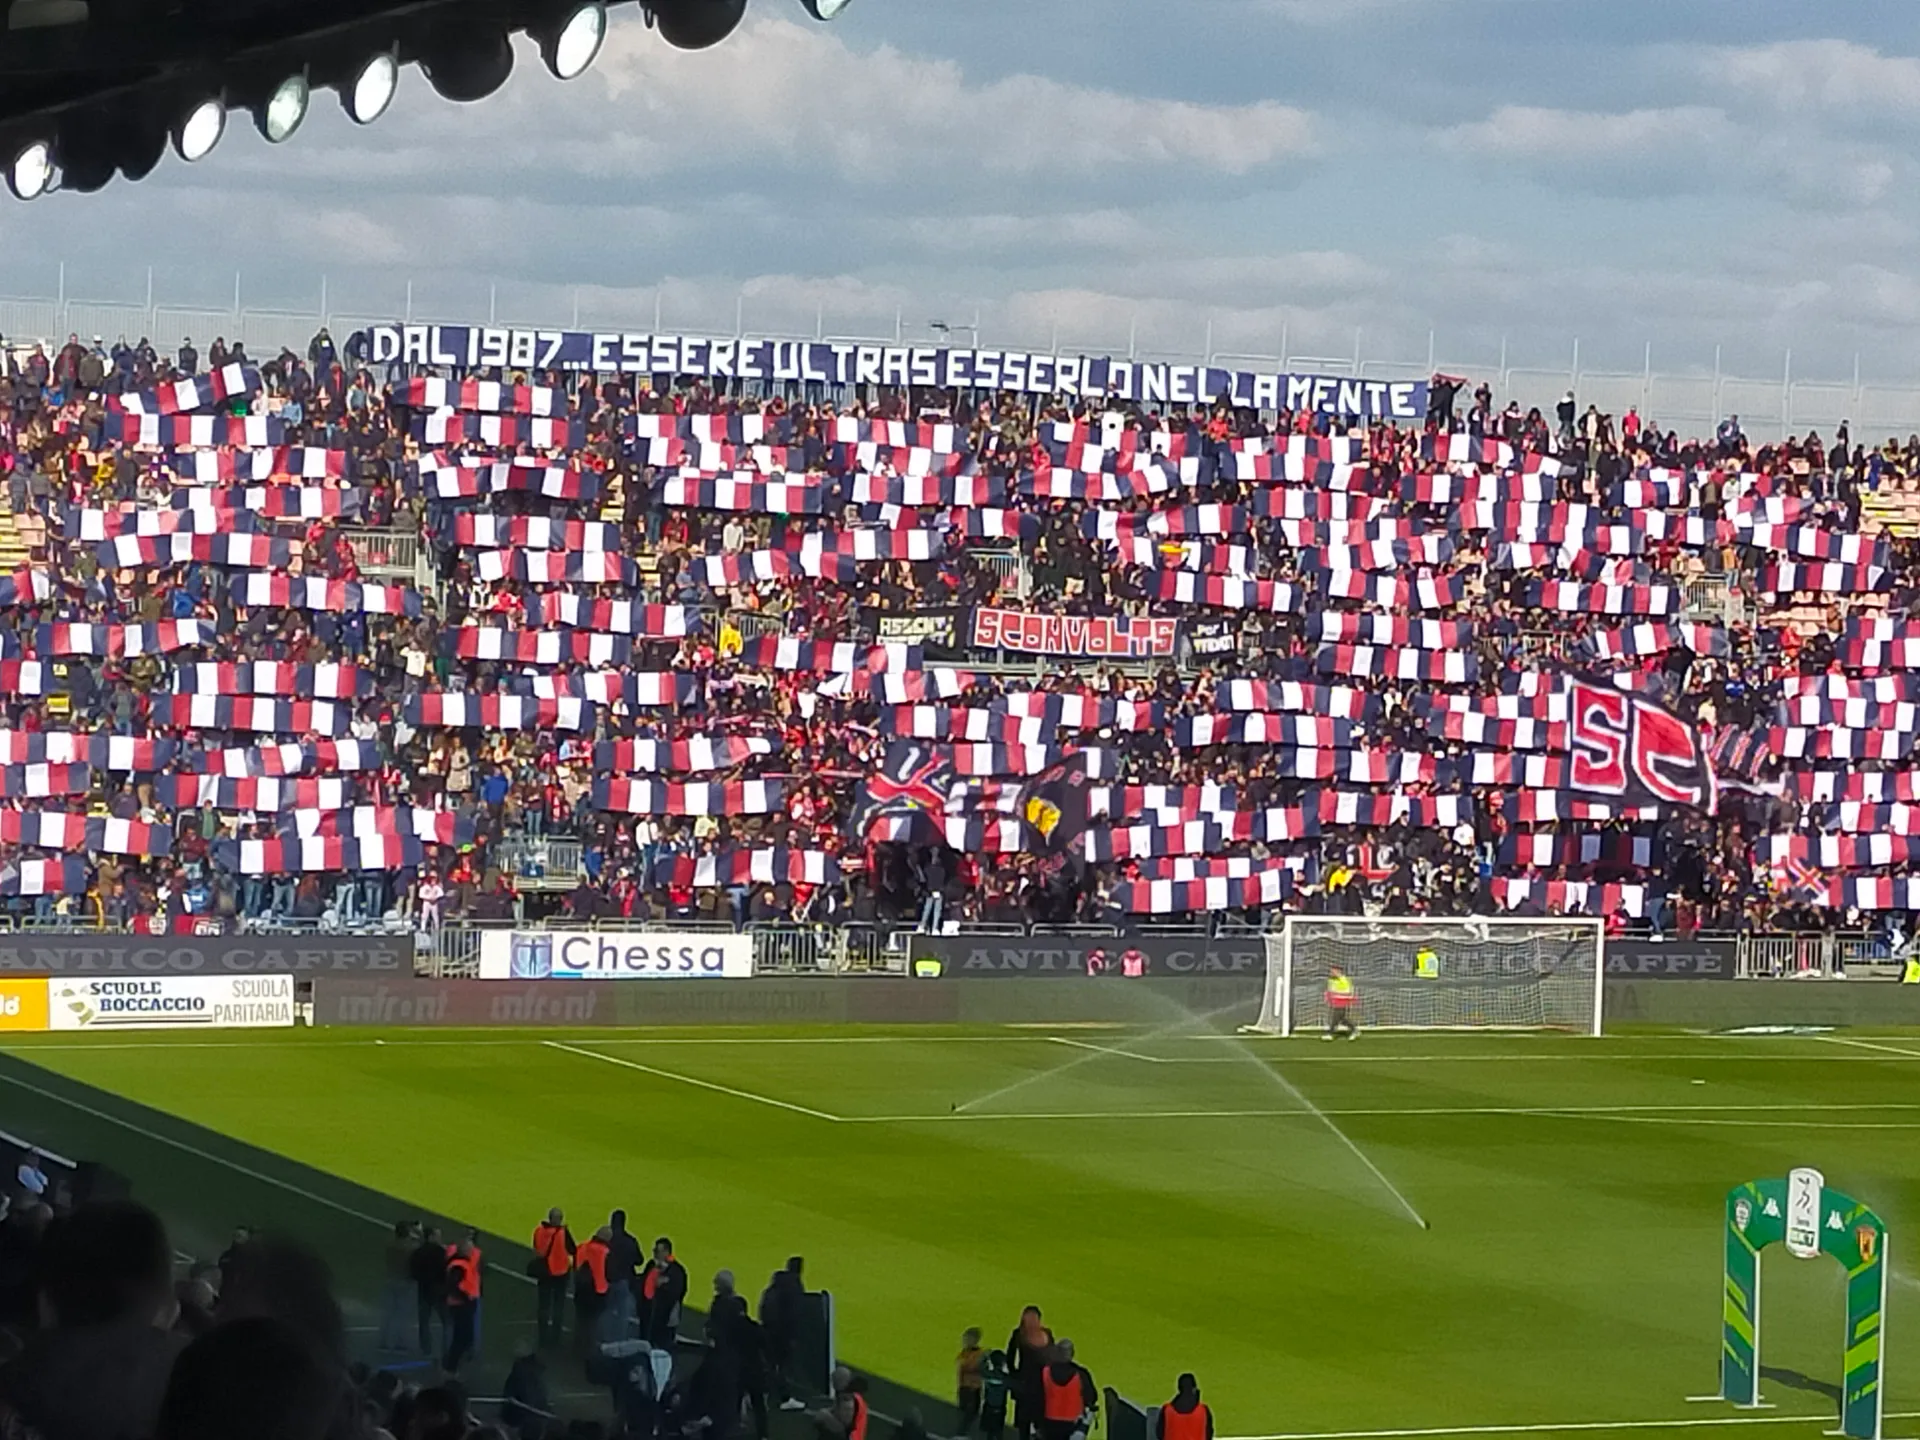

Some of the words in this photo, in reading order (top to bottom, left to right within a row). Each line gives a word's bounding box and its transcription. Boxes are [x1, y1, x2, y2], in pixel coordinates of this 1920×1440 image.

[373, 326, 456, 365] DAL
[593, 333, 763, 377] ESSERE
[773, 342, 936, 386] ULTRAS
[946, 349, 1132, 399] ESSERLO
[1287, 375, 1416, 416] MENTE
[974, 608, 1177, 656] SCONVOLTS
[0, 947, 205, 970] ANTICO
[221, 942, 399, 970] CAFFÈ
[561, 937, 724, 972] Chessa
[90, 982, 162, 995] SCUOLE
[232, 979, 290, 998] SCUOLA
[100, 997, 206, 1012] BOCCACCIO
[213, 1002, 291, 1024] PARITARIA
